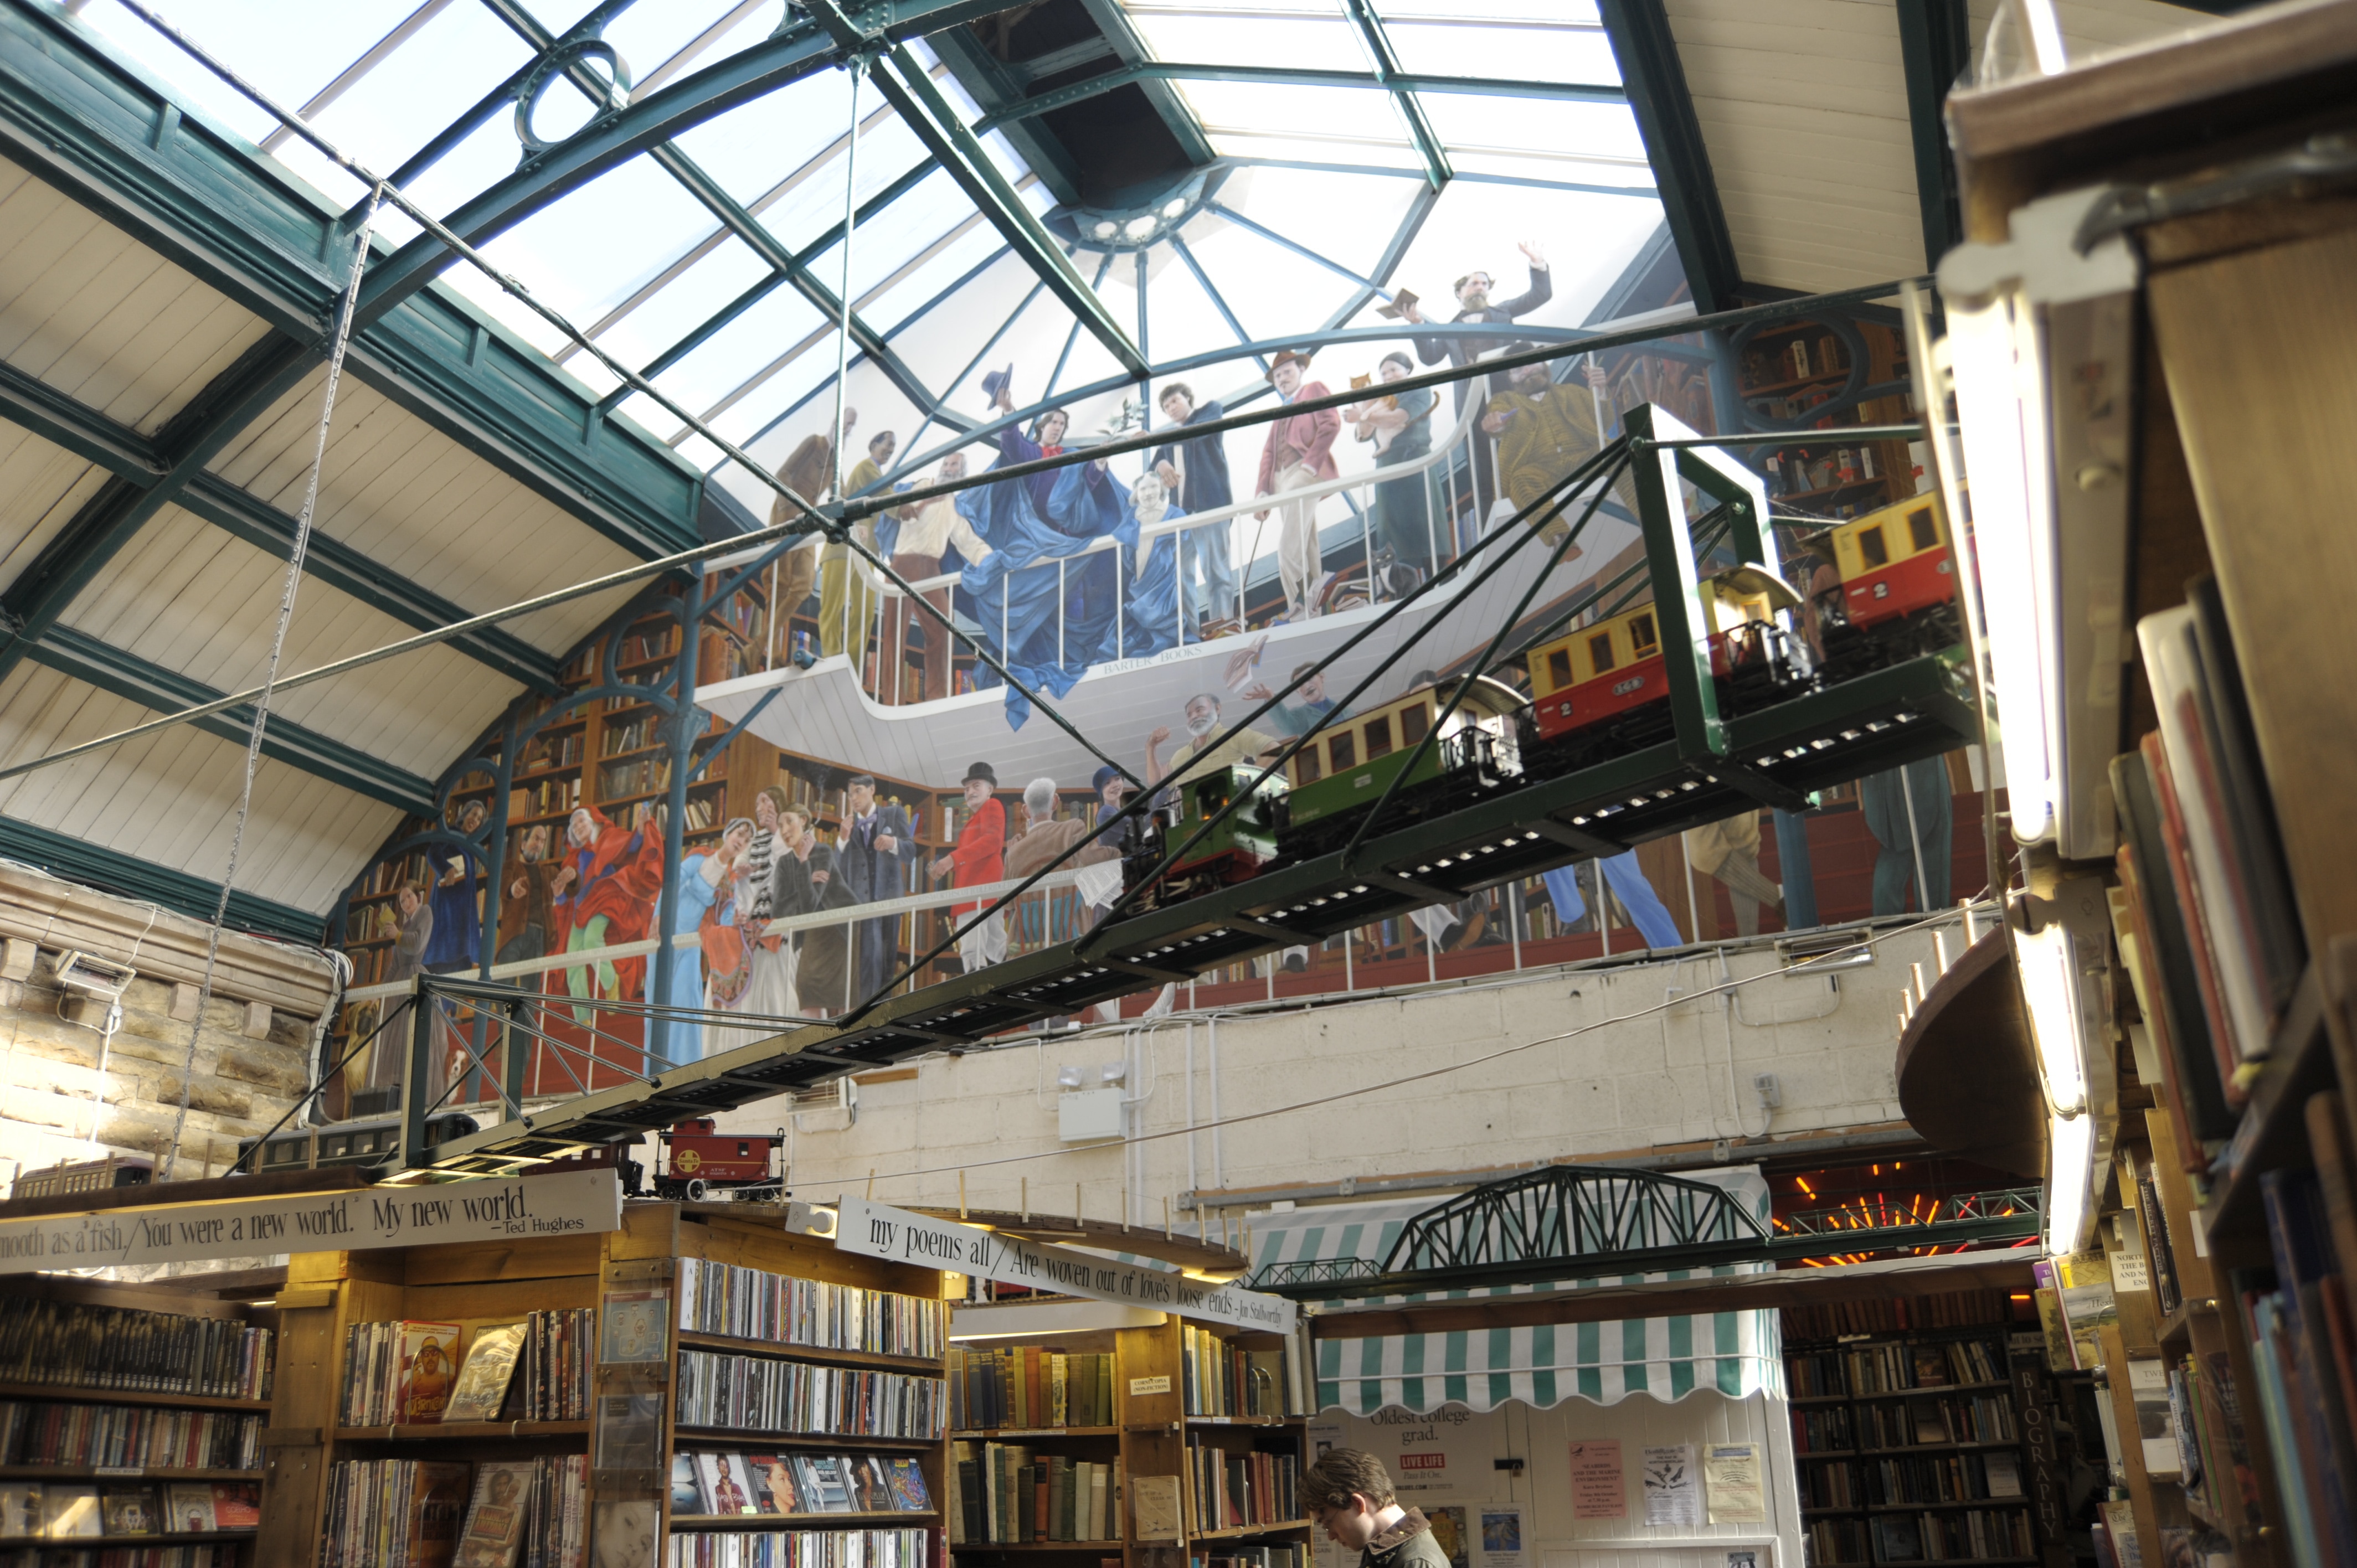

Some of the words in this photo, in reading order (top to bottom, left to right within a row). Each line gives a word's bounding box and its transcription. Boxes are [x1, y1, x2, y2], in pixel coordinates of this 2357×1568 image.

[1874, 584, 1887, 599] 2
[1104, 657, 1152, 674] BARTER
[1161, 646, 1202, 662] BOOKS
[1560, 703, 1572, 716] 2
[52, 1231, 70, 1255] as
[75, 1231, 85, 1253] a
[179, 1218, 223, 1244] were
[231, 1218, 243, 1240] a
[250, 1213, 288, 1240] new
[295, 1198, 354, 1235] world.
[372, 1197, 404, 1238] My
[411, 1199, 452, 1227] new
[461, 1184, 533, 1223] world.
[533, 1217, 584, 1234] Hughes
[2152, 1237, 2163, 1272] FACTOR
[869, 1218, 898, 1253] my
[905, 1225, 962, 1260] poems
[970, 1236, 990, 1267] all
[1010, 1242, 1038, 1277] Are
[1046, 1258, 1089, 1288] woven
[1096, 1268, 1115, 1292] out
[1121, 1271, 1135, 1296] of
[1140, 1274, 1170, 1303] love's
[1177, 1281, 1203, 1309] loose
[1209, 1292, 1232, 1315] ends
[1250, 1303, 1282, 1327] Stallworthy
[1371, 1410, 1416, 1426] Oldest
[1420, 1407, 1470, 1426] college
[1402, 1426, 1438, 1446] grad.
[1402, 1456, 1422, 1468] LIVE
[1424, 1455, 1443, 1467] LIFE
[2022, 1371, 2056, 1538] BIOGRAPHY
[1403, 1471, 1419, 1480] Pass
[1420, 1471, 1427, 1479] It
[1427, 1470, 1442, 1478] On.
[731, 1544, 737, 1552] D
